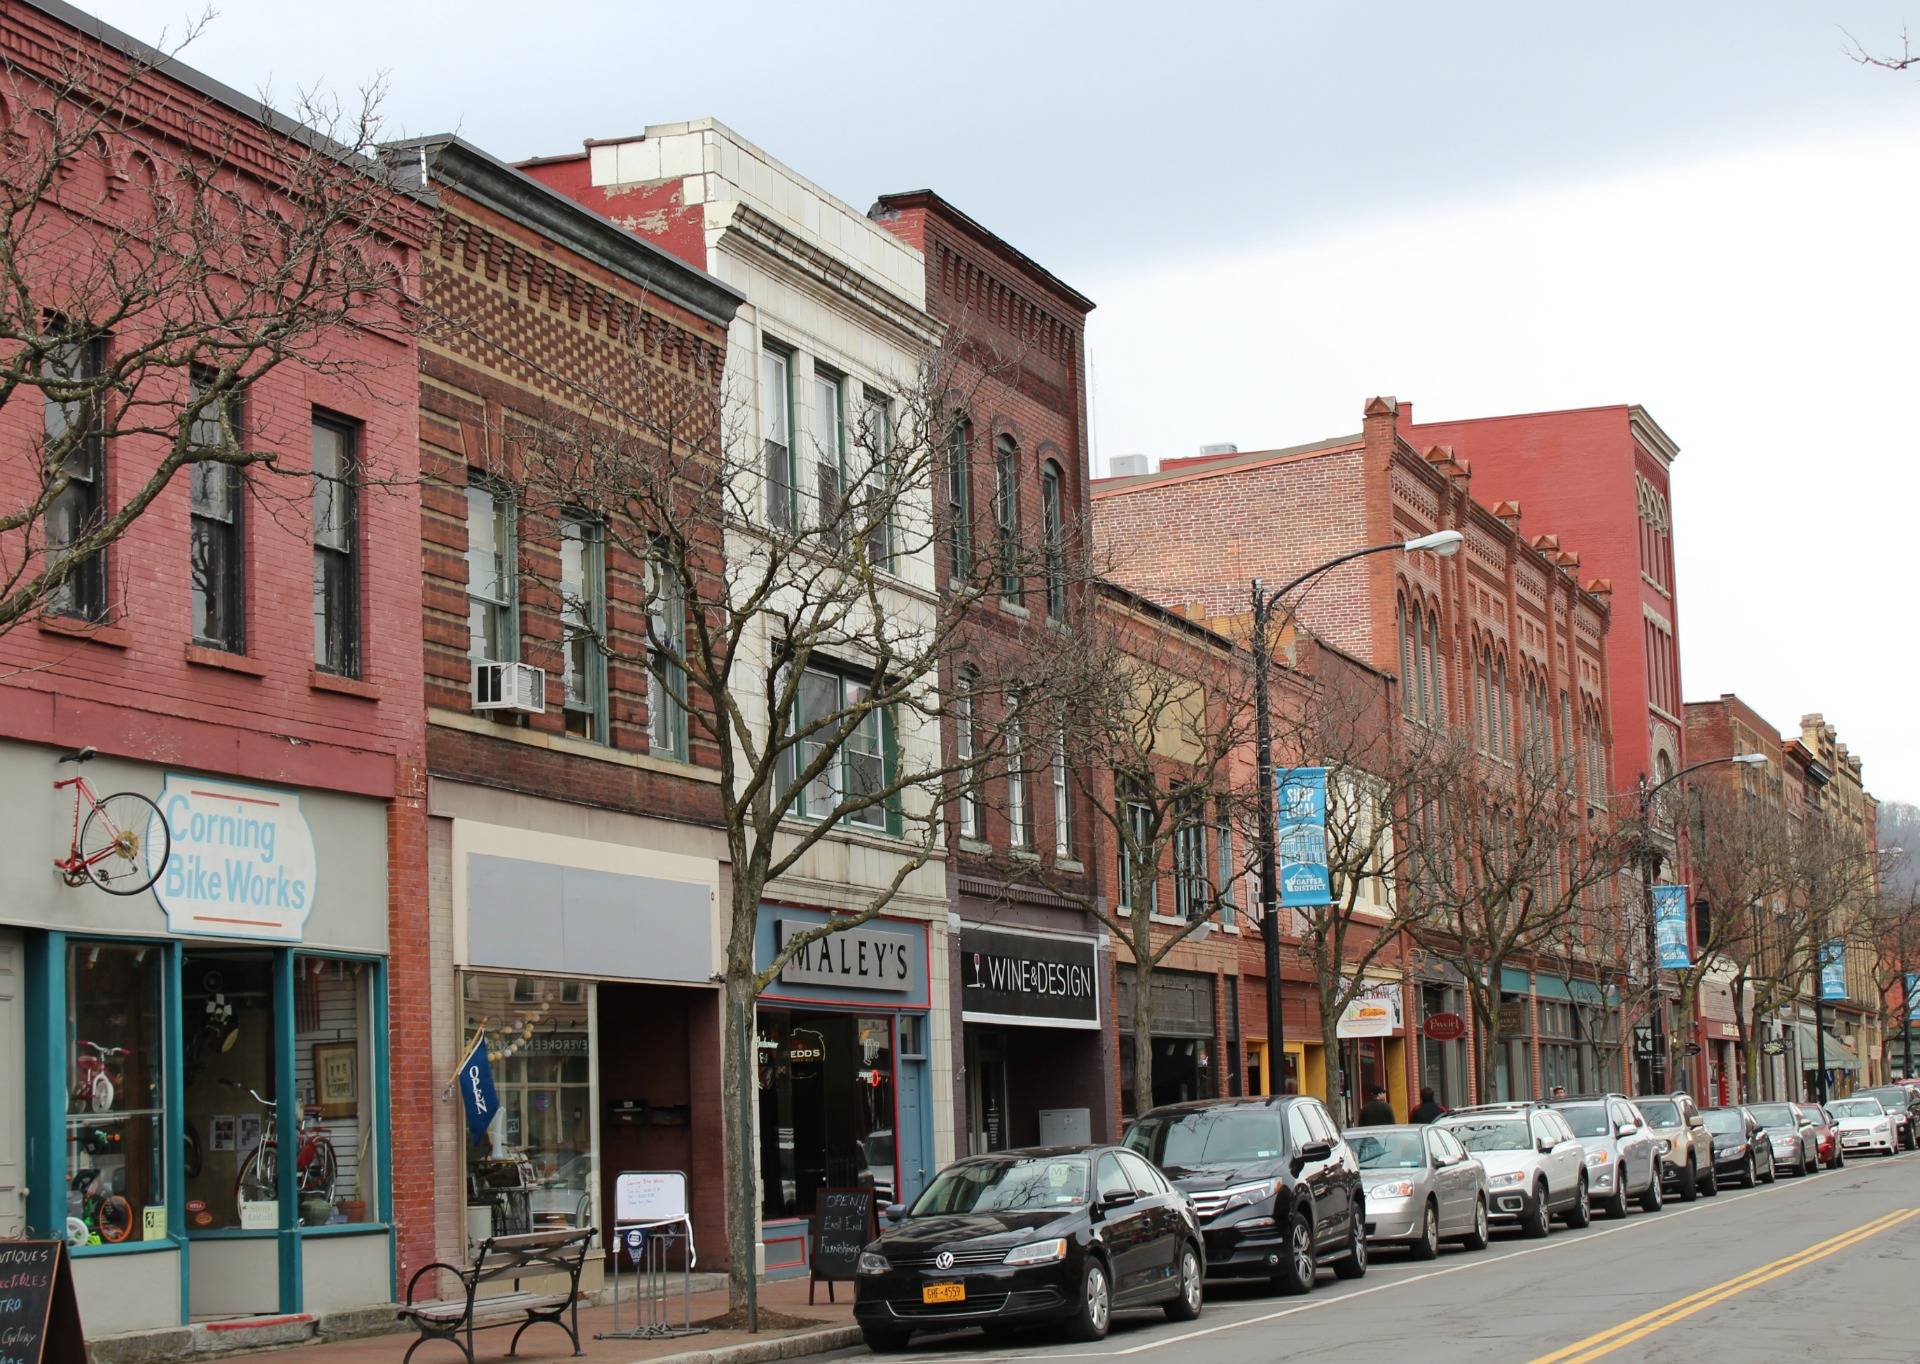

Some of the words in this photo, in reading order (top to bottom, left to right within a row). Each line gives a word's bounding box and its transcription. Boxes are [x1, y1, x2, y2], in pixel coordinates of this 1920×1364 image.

[166, 794, 276, 863] Corning
[165, 852, 222, 901] Bike
[225, 858, 305, 910] Works
[469, 1065, 488, 1115] OPEN
